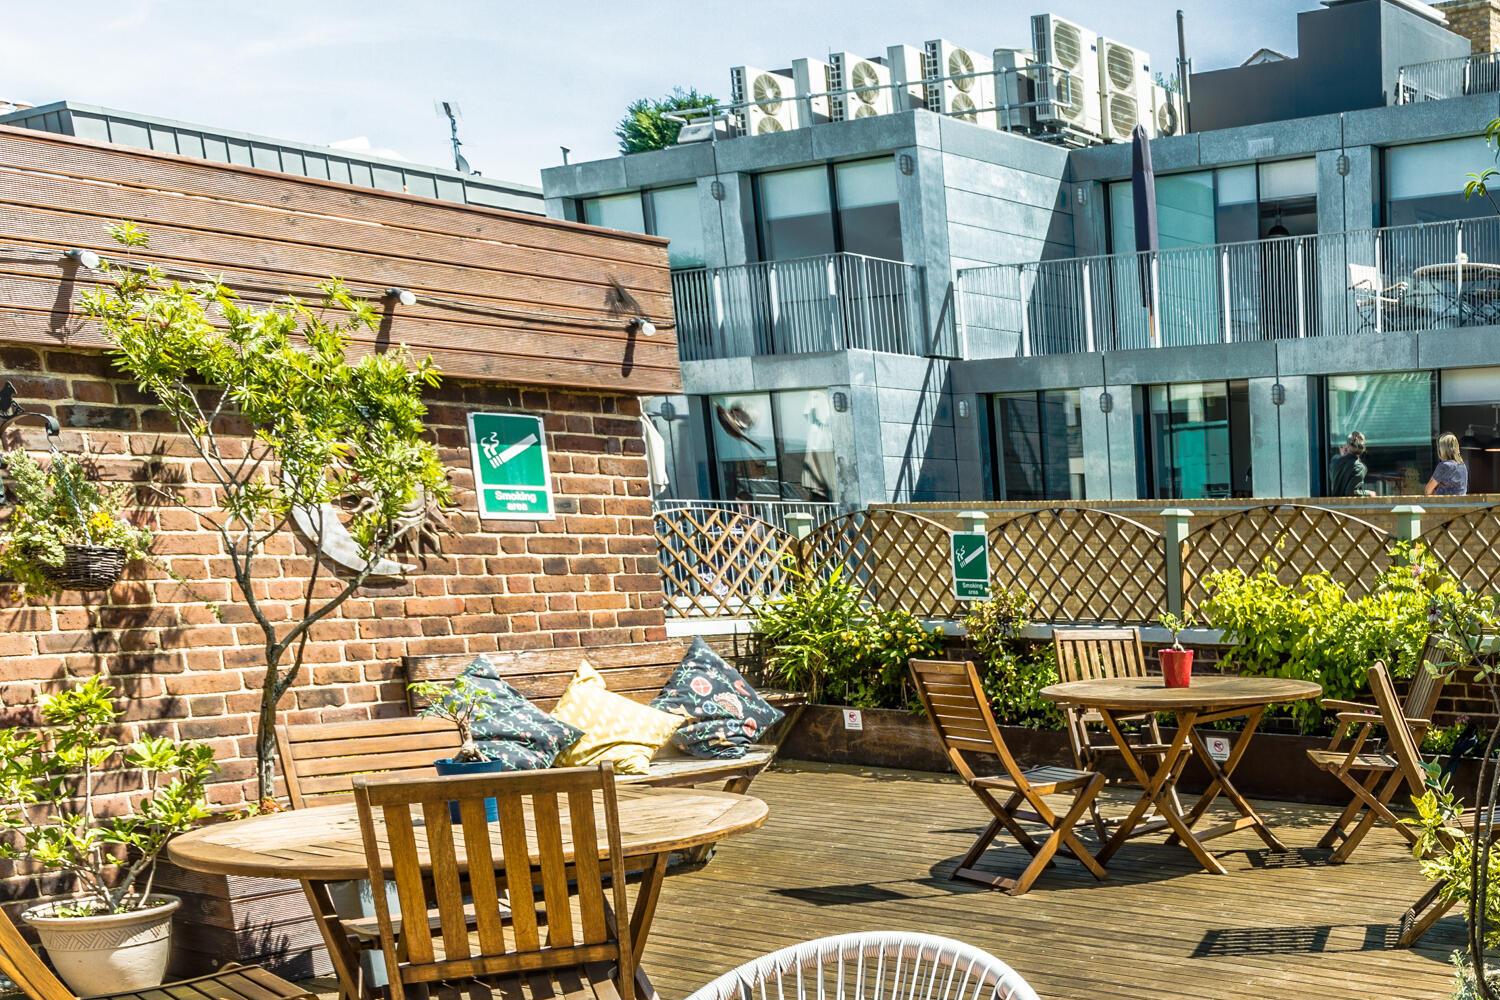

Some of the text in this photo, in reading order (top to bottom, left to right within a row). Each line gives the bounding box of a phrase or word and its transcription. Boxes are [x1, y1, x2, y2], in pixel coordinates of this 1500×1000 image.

[494, 490, 537, 504] Smoking
[506, 502, 528, 511] area
[962, 582, 983, 590] Smoking
